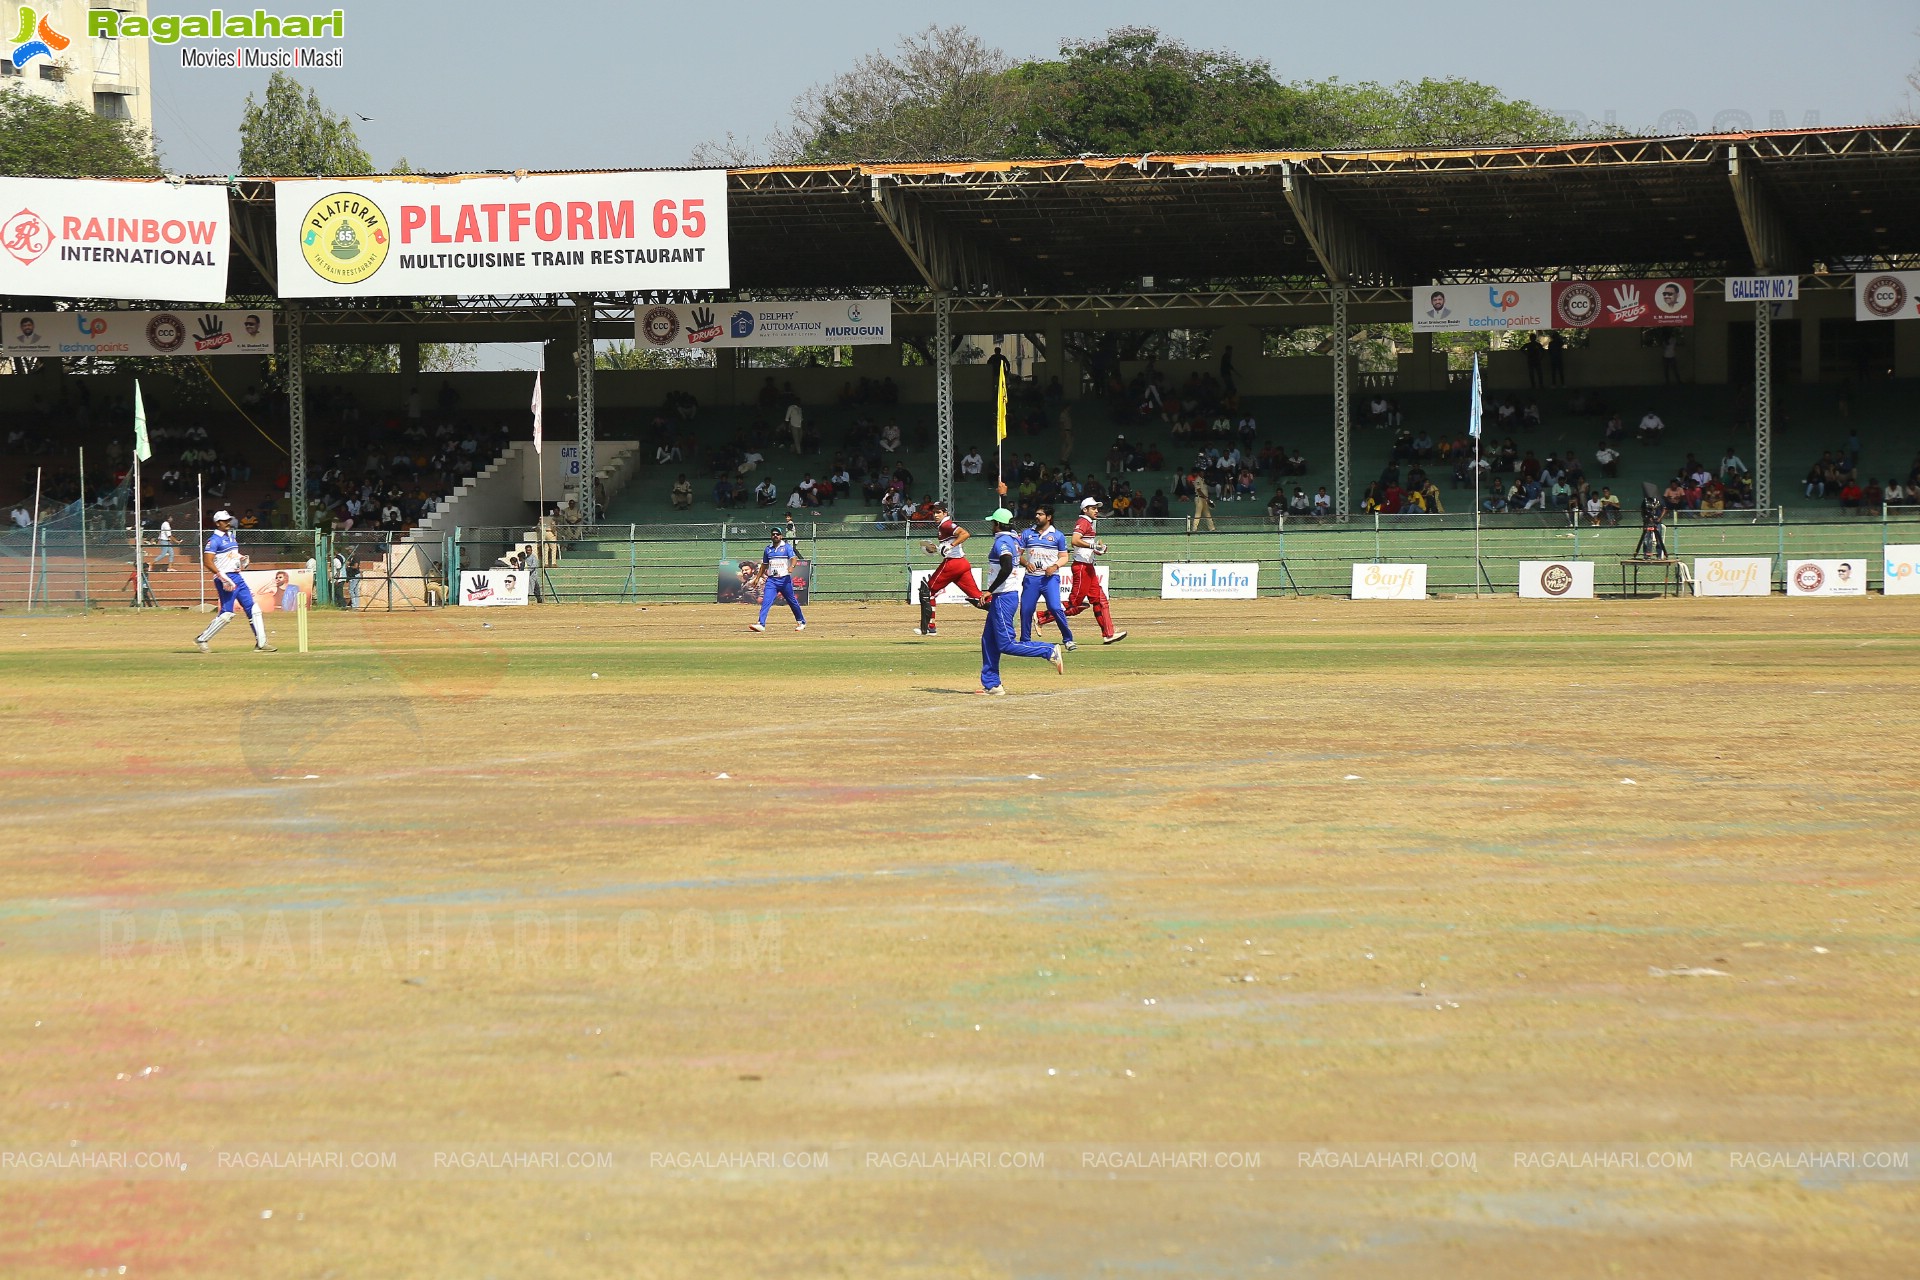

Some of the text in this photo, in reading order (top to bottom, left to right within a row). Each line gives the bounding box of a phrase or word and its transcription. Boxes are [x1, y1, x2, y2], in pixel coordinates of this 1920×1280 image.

[311, 200, 378, 228] PLATFORM
[400, 198, 706, 244] PLATFORM 65
[63, 216, 217, 245] RAINBOW
[339, 231, 352, 240] 65
[61, 246, 216, 266] INTERNATIONAL
[400, 247, 706, 269] MULTICUISINE TRAIN RESTAURANT
[343, 253, 377, 276] RESTAURANT
[1732, 279, 1793, 298] GALLERY NO 2
[1877, 292, 1894, 300] CCC
[1571, 301, 1588, 309] CCC
[1614, 305, 1646, 322] DRUGS
[653, 322, 669, 330] CCC
[759, 322, 822, 331] AUTOMATION
[1468, 315, 1541, 328] technopaints
[158, 328, 175, 337] CCC
[692, 328, 720, 342] DRUGS
[825, 326, 884, 337] MURUGUN
[59, 341, 129, 354] technopaints
[200, 334, 230, 348] DRUGS
[561, 447, 577, 458] GATE
[570, 460, 579, 475] 8
[1170, 569, 1249, 587] Srini Infra
[1364, 565, 1415, 596] Barfi
[1706, 560, 1758, 593] Barfi
